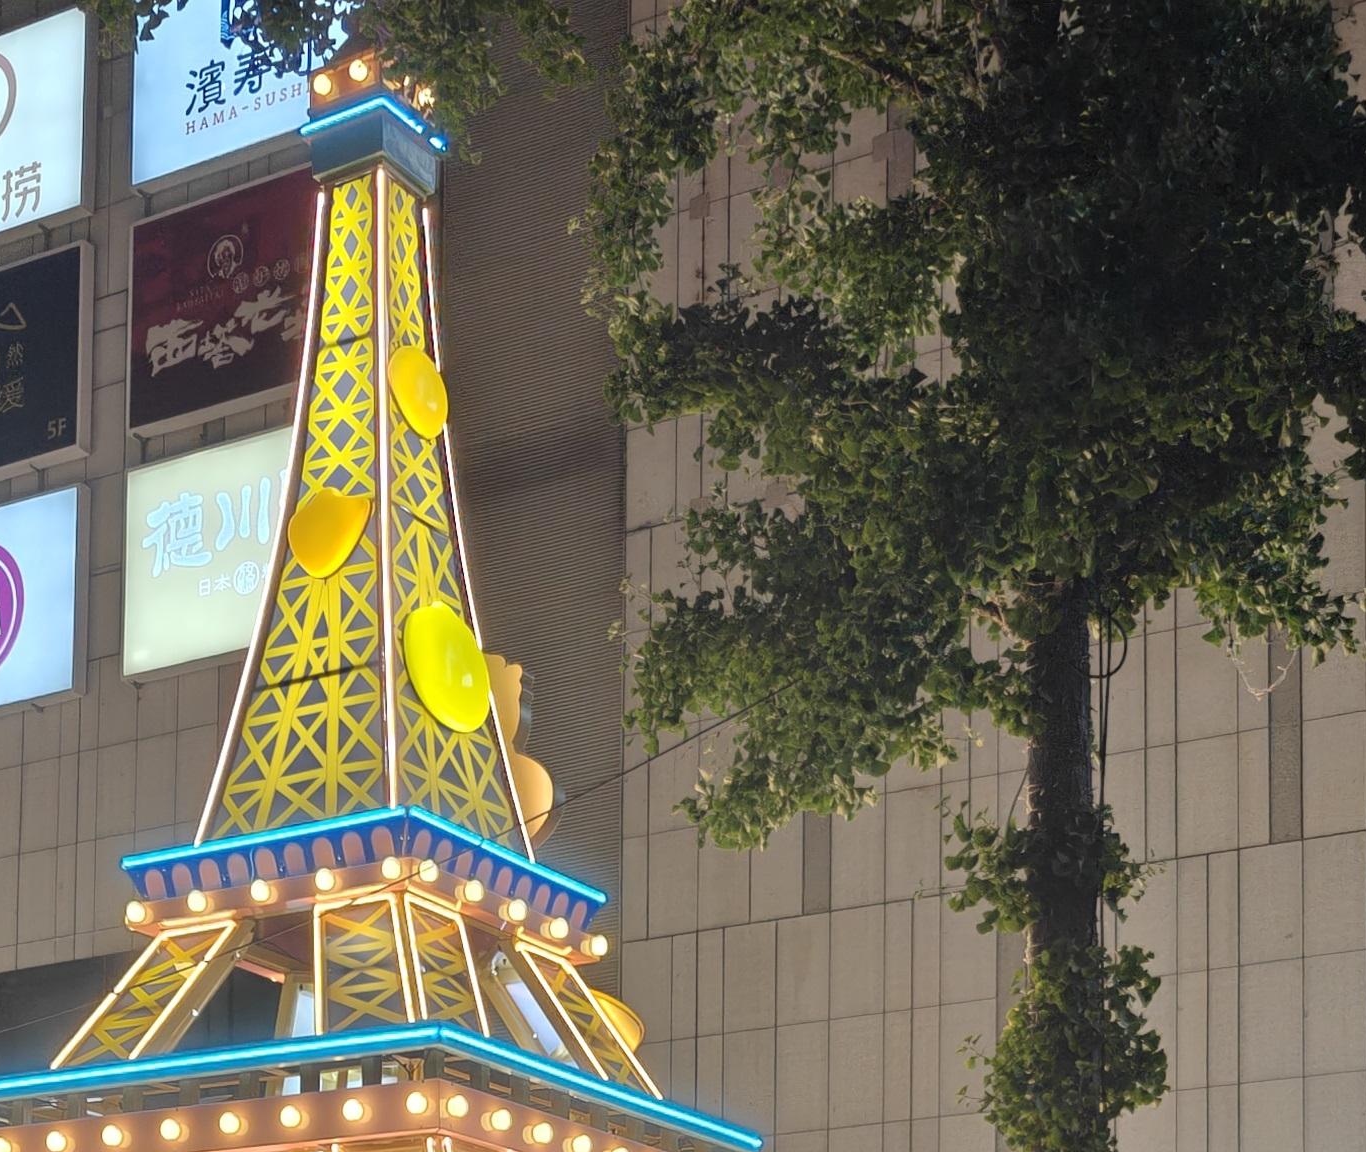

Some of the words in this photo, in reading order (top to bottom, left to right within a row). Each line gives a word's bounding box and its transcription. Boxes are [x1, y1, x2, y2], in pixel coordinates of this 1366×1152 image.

[186, 40, 312, 116] 濱寿
[47, 417, 68, 440] 5F
[141, 470, 287, 578] 德川
